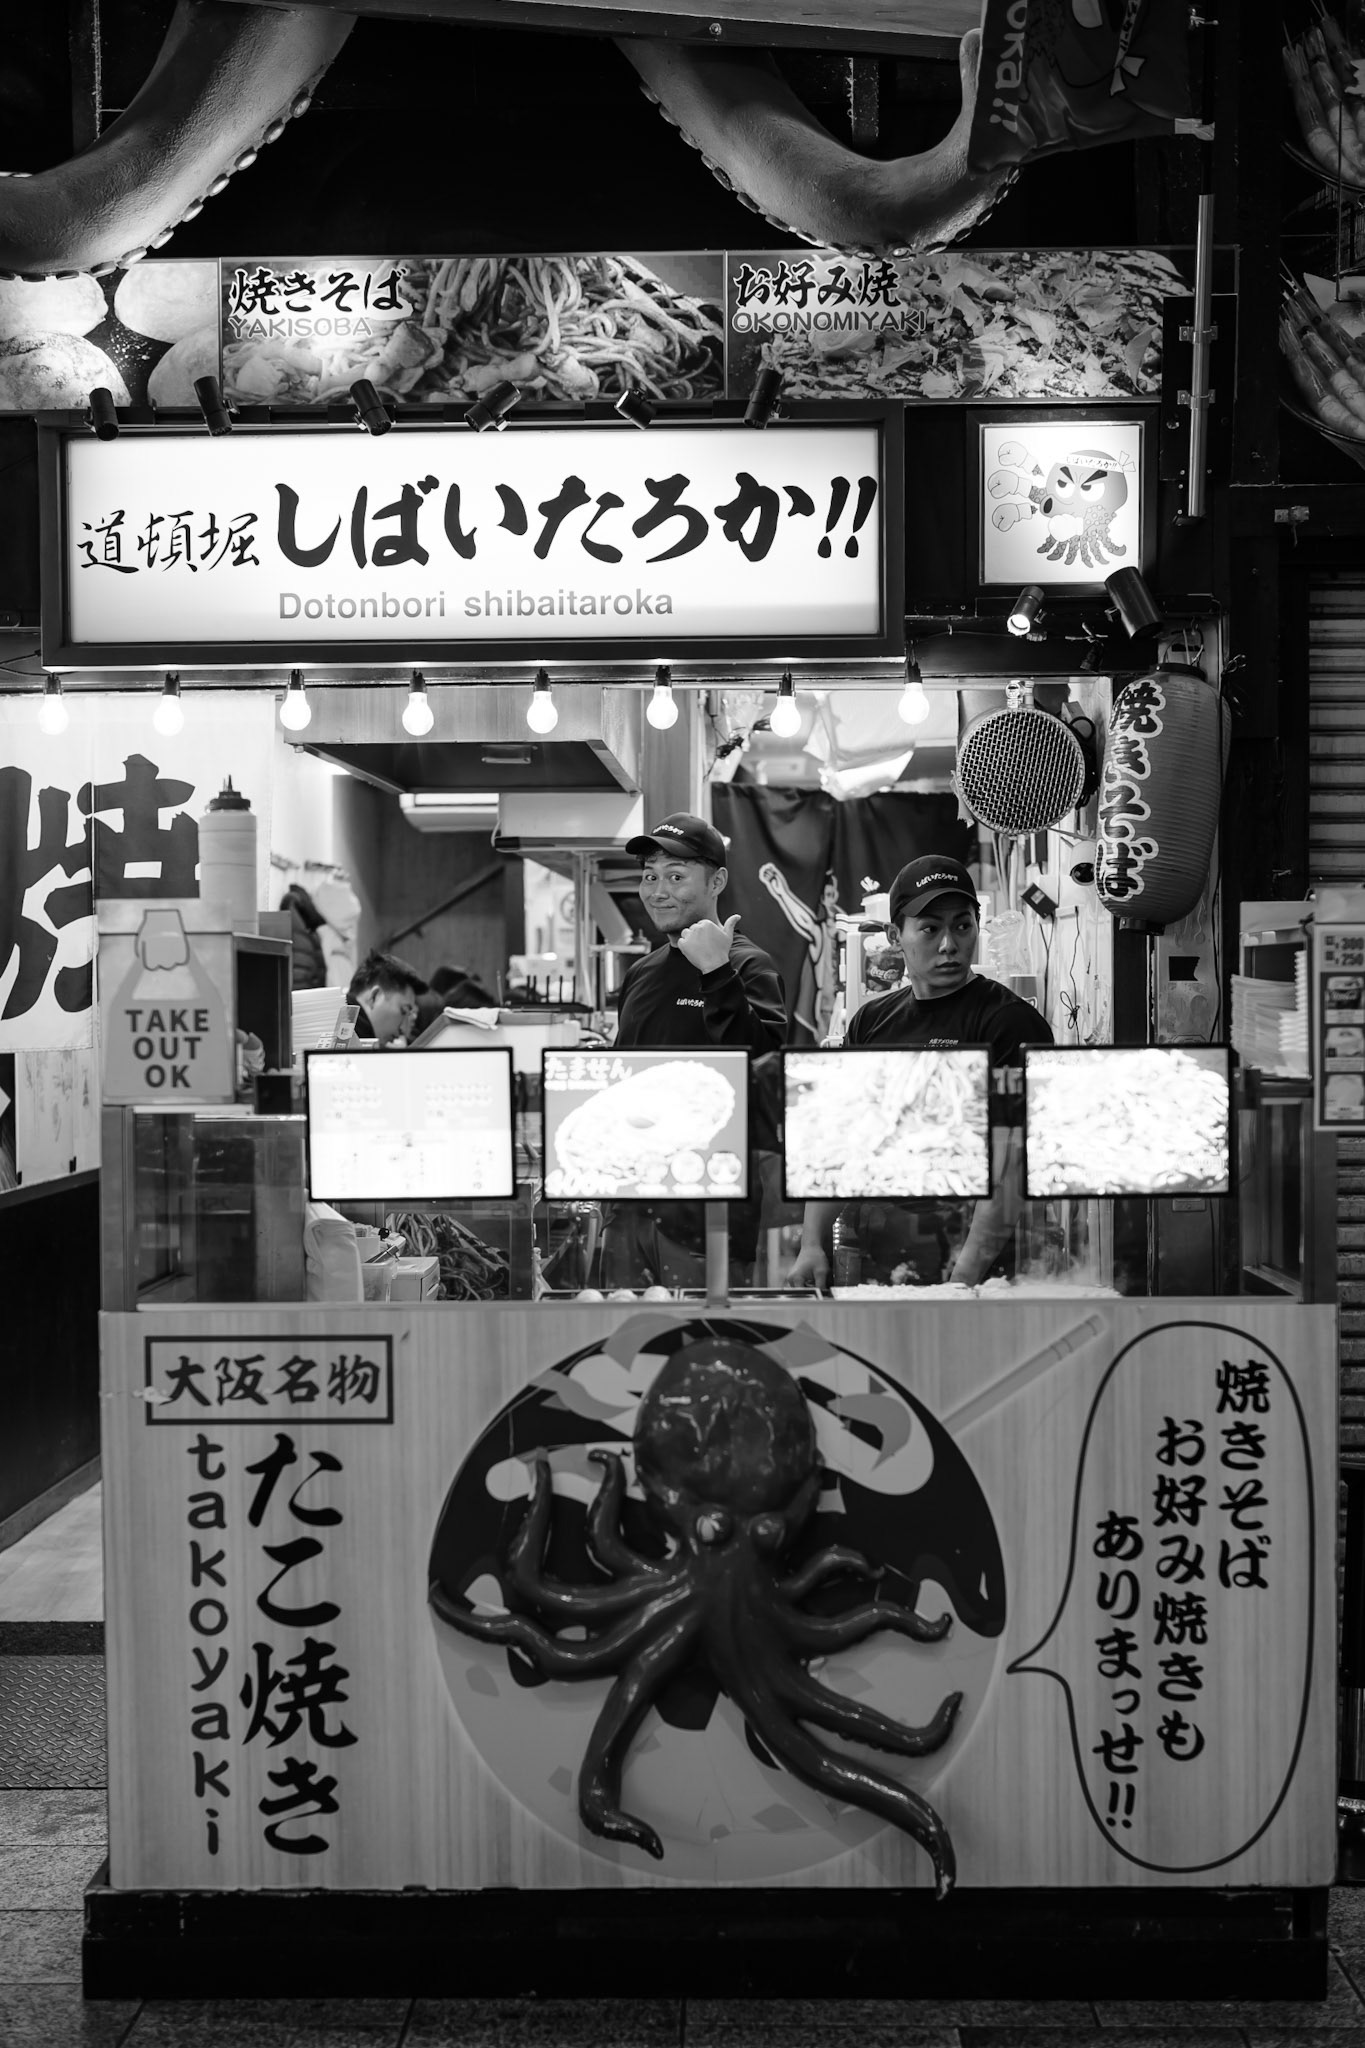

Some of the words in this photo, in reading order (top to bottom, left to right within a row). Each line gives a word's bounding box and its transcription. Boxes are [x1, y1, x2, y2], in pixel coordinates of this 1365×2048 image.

[230, 267, 407, 316] 焼きそば
[733, 260, 902, 309] お好み焼
[229, 316, 373, 338] YAKISOBA
[732, 310, 926, 333] OKONOMIYAKI
[77, 510, 259, 573] 道頓堀
[275, 472, 878, 570] しばいたろか!!
[280, 591, 446, 619] Dotonbori
[464, 588, 673, 617] shibaitaroka
[1096, 679, 1160, 899] 焼きそば
[125, 1009, 210, 1033] TAKE
[133, 1037, 203, 1060] OUT
[545, 1057, 633, 1080] たません
[144, 1065, 192, 1088] OK
[162, 1355, 380, 1407] 大阪名物
[1216, 1360, 1270, 1590] 焼きそば
[1152, 1416, 1208, 1762] お好み焼きも
[187, 1433, 231, 1856] takoyaki
[240, 1433, 359, 1856] たこ焼き
[1092, 1510, 1145, 1829] ありまっせ!!
